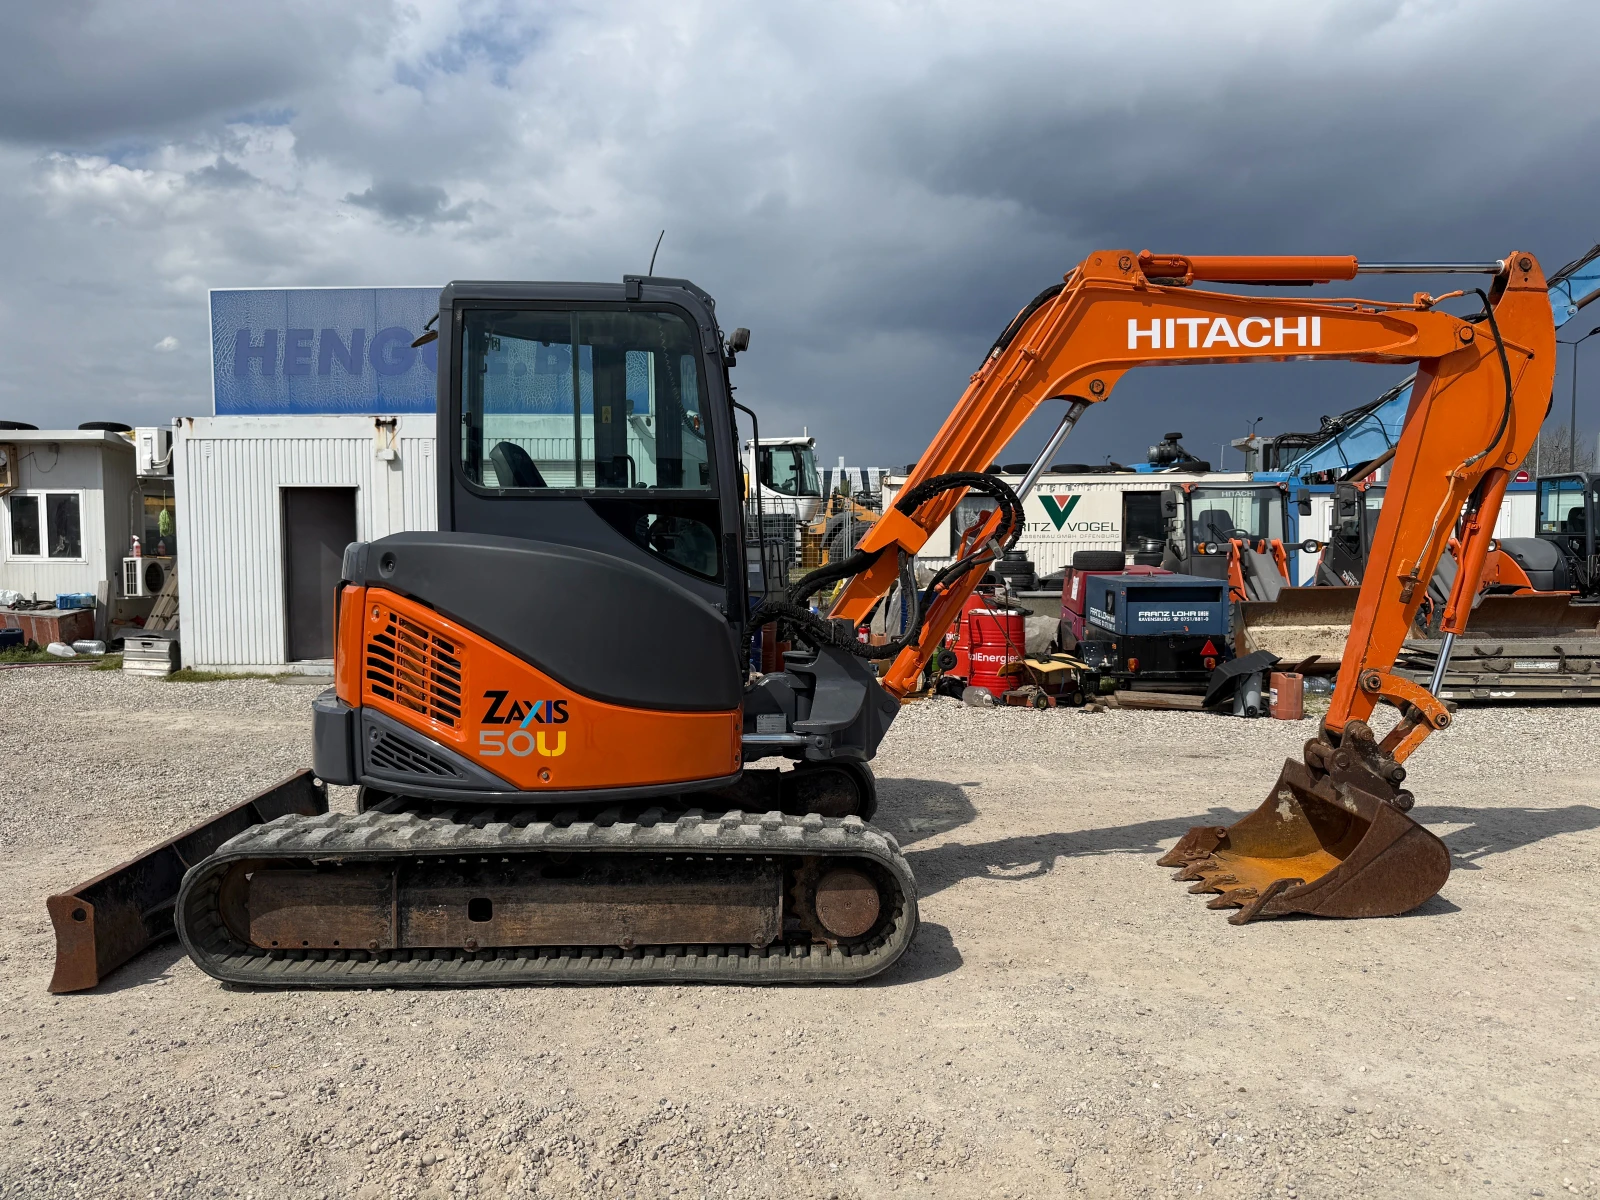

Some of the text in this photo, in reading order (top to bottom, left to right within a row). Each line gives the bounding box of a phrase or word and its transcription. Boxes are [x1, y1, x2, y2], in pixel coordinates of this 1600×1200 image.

[1127, 316, 1321, 349] HITACHI
[1067, 522, 1120, 532] VOGEL
[481, 690, 569, 728] ZAXIS
[479, 730, 567, 757] 50U
